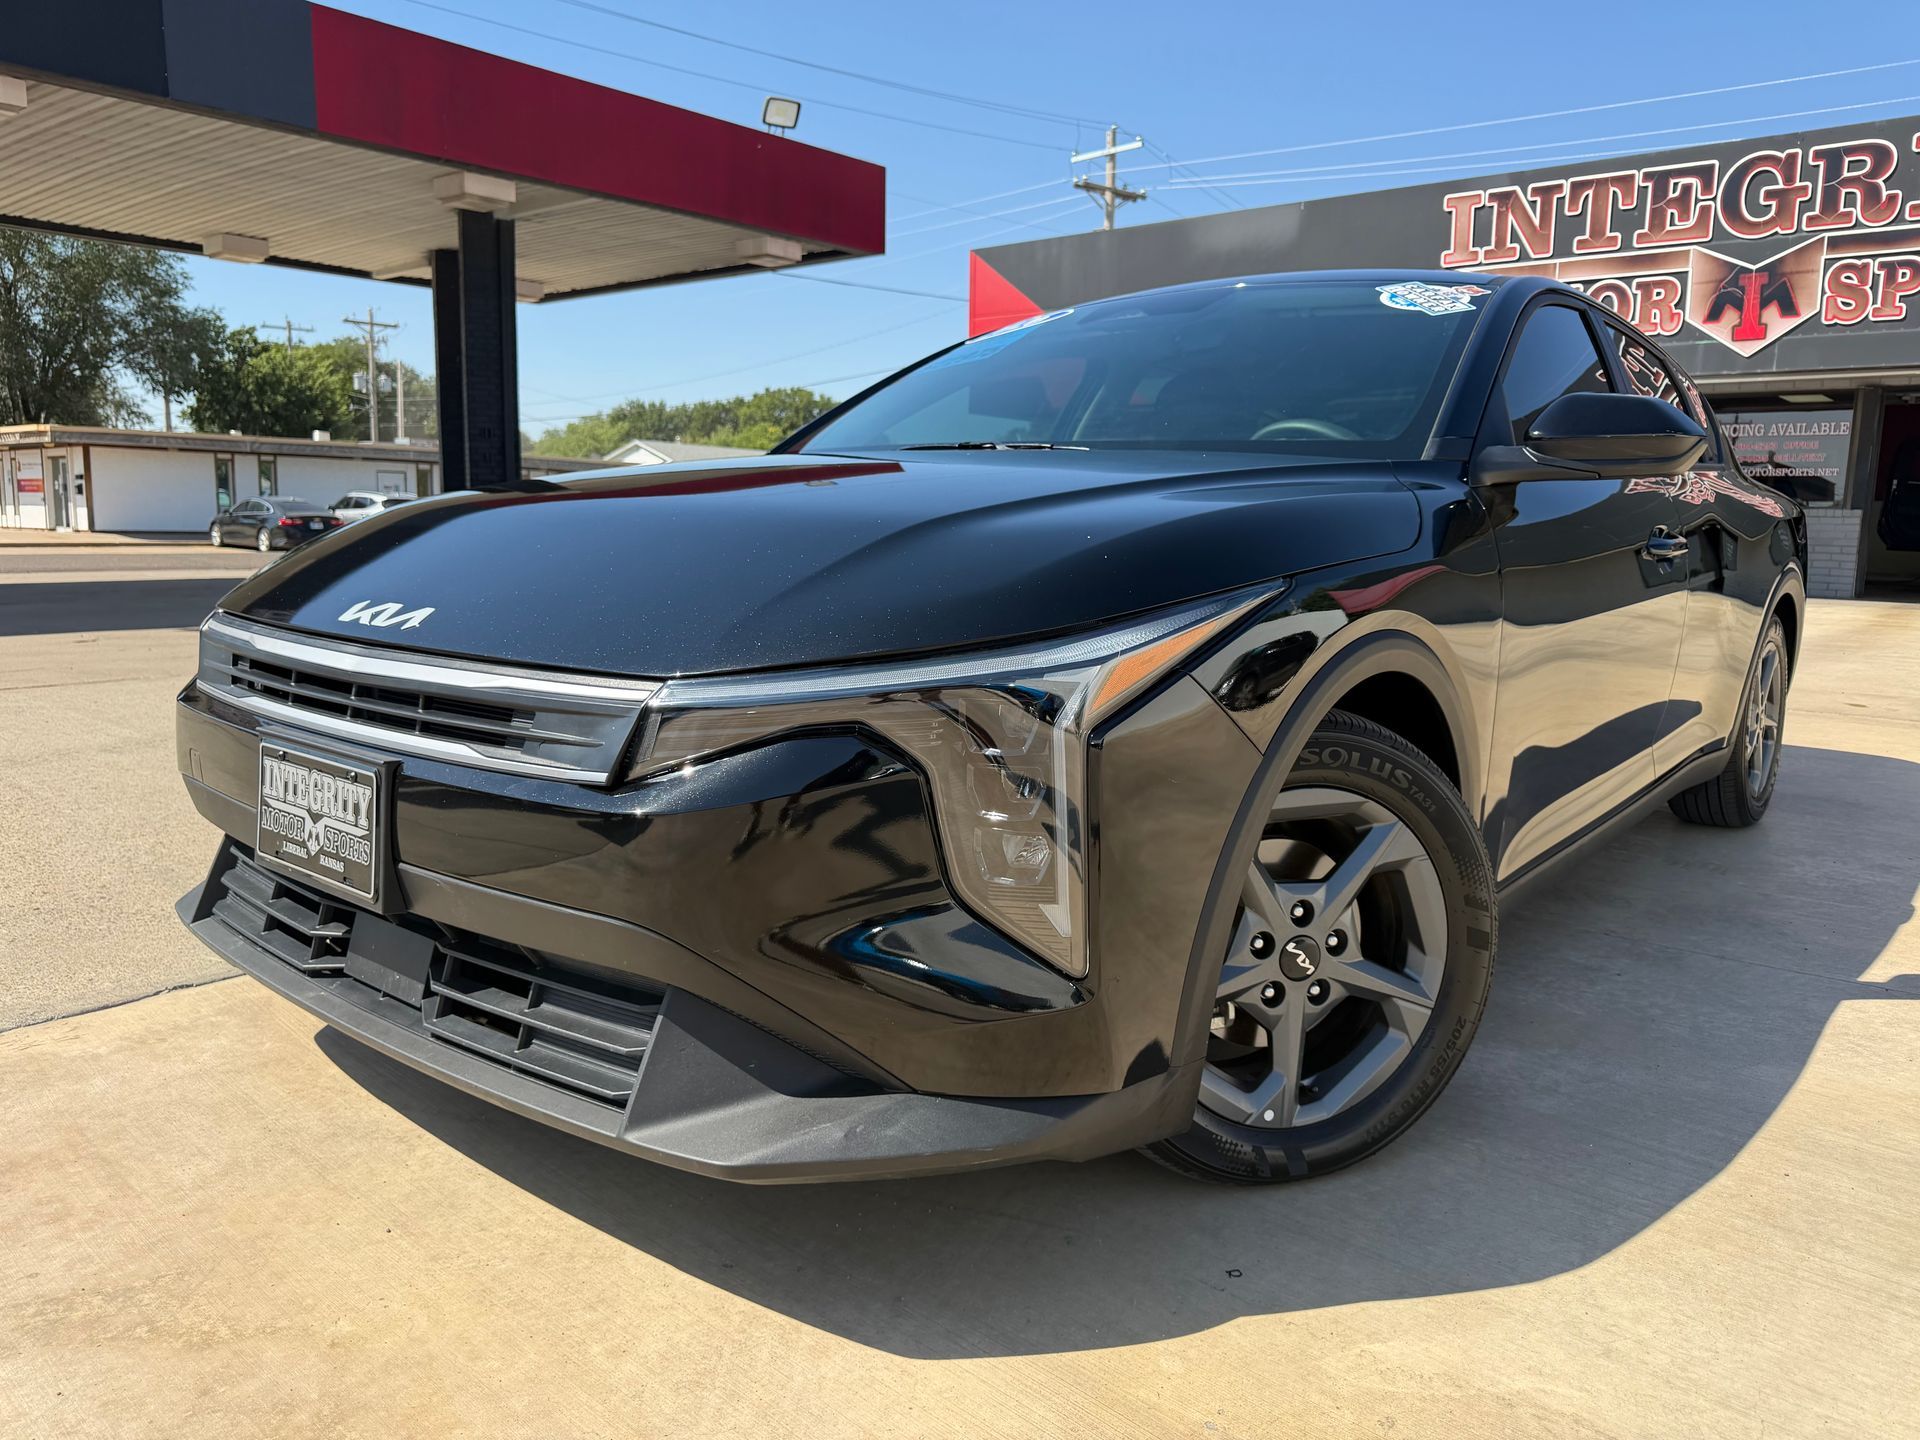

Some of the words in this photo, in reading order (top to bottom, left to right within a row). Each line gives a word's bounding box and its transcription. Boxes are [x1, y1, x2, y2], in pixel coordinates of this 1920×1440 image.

[1441, 132, 1920, 267] INTEGR
[1569, 275, 1683, 336] OR
[1768, 421, 1850, 436] AVAILABLE
[263, 756, 372, 829] INTEGRITY
[1300, 747, 1413, 789] SOLUS
[1407, 786, 1437, 813] TA31
[262, 806, 305, 841] MOTOR
[324, 827, 370, 865] SPORTS
[282, 841, 309, 859] LIBERAL
[320, 854, 345, 873] KANSAS
